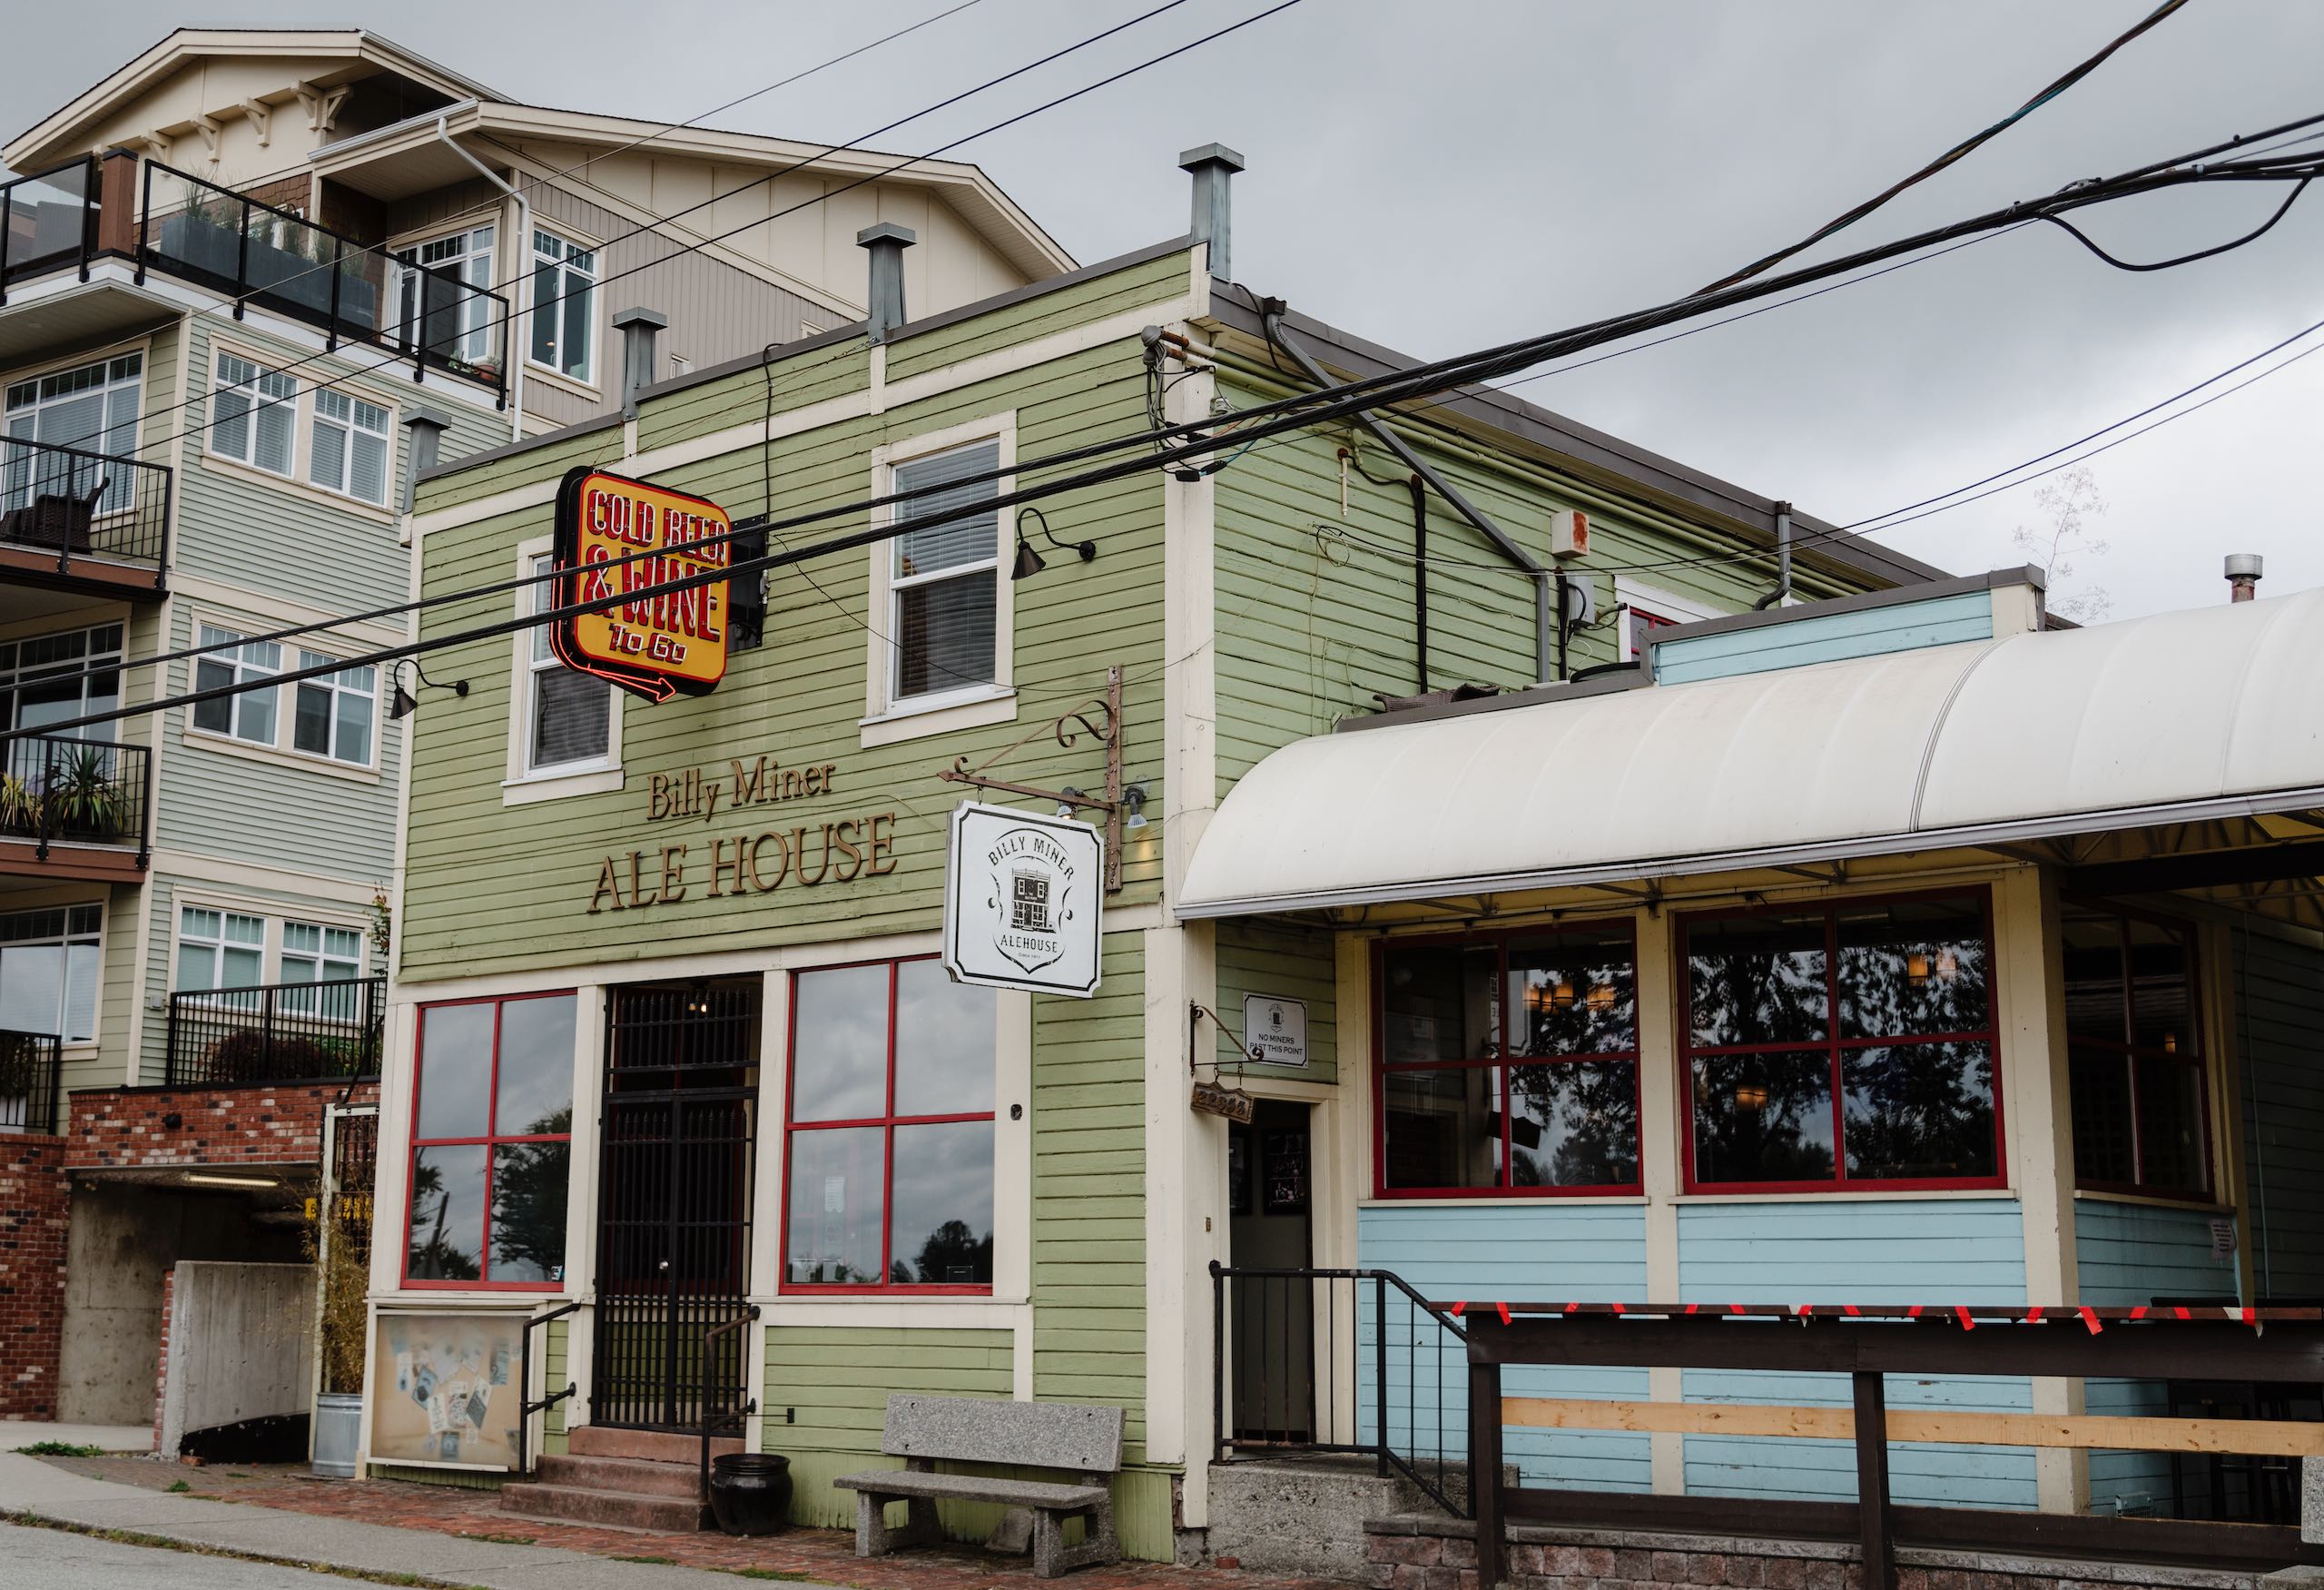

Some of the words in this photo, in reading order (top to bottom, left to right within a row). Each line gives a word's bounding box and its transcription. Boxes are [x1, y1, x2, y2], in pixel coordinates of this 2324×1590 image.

[587, 489, 656, 547] COLD
[664, 508, 726, 566] BEER
[584, 545, 615, 618] &
[622, 548, 721, 643] WINE
[646, 773, 720, 822] Billy
[731, 755, 836, 806] Miner
[587, 844, 687, 913] ALE
[707, 812, 898, 897] HOUSE
[988, 836, 1026, 866] BILLY
[1033, 837, 1075, 882] MINER
[1000, 933, 1059, 953] ALEHOUSE
[1249, 1042, 1267, 1051] PAST
[1267, 1044, 1283, 1053] THIS
[1283, 1046, 1304, 1055] POINT
[1258, 1033, 1269, 1042] NO
[1270, 1034, 1295, 1044] MINERS
